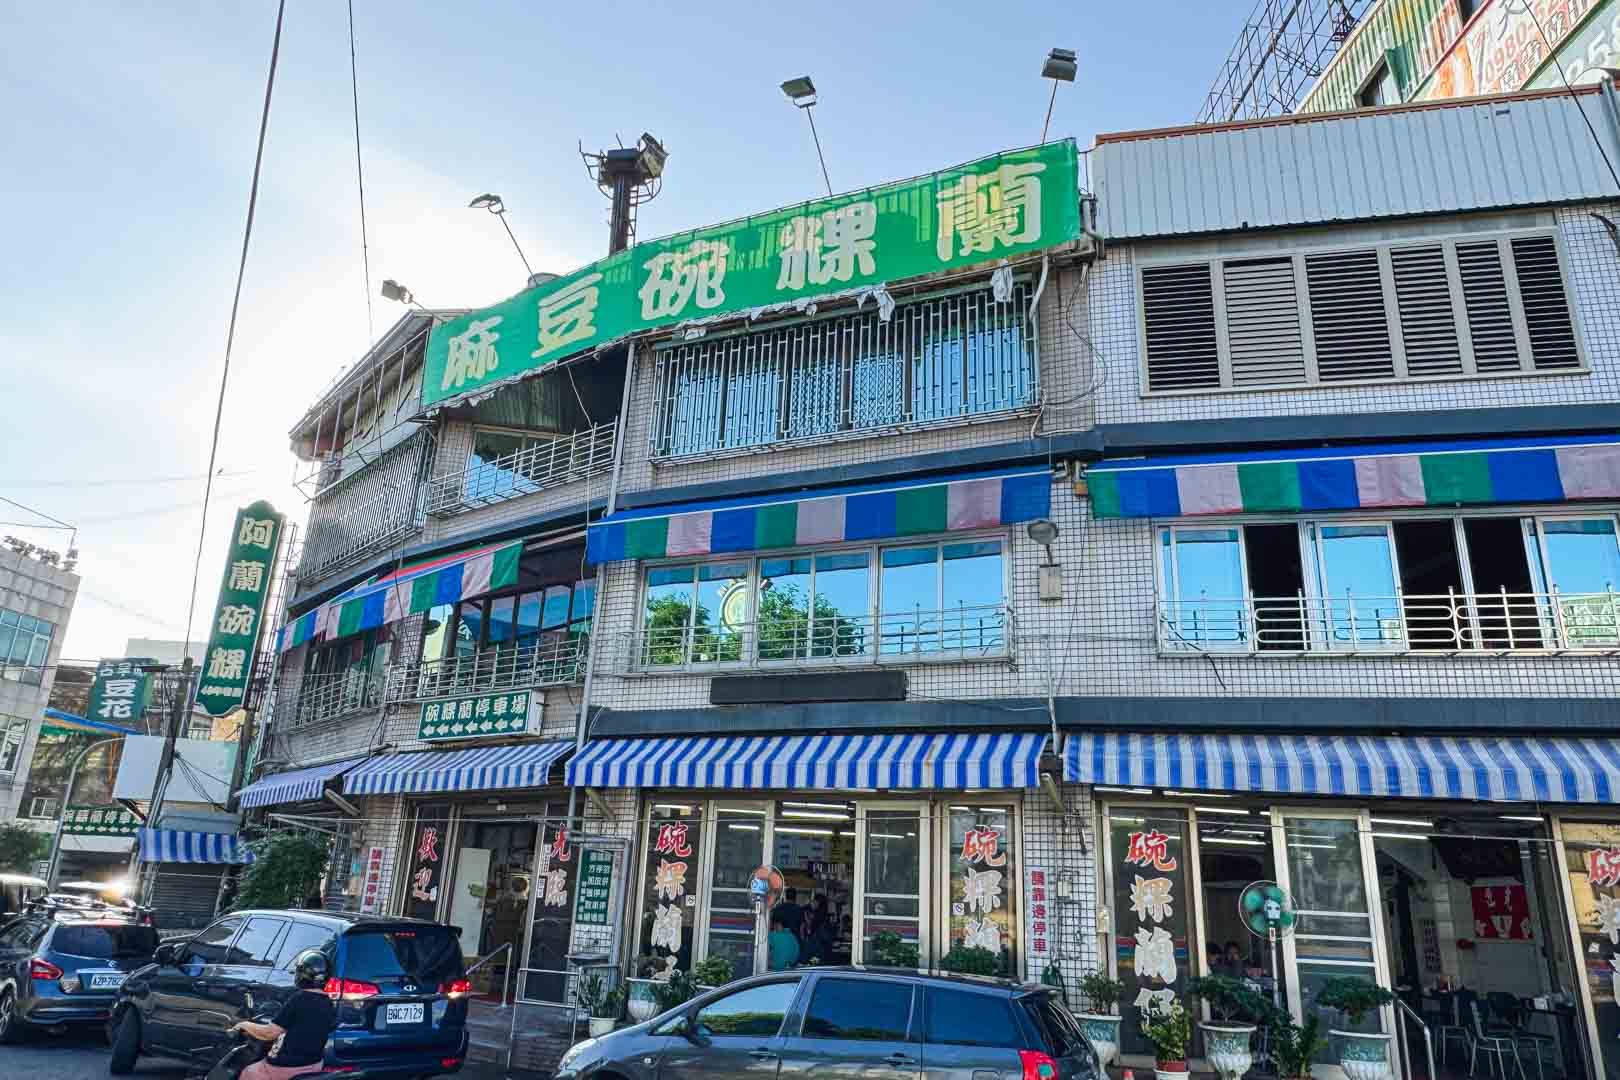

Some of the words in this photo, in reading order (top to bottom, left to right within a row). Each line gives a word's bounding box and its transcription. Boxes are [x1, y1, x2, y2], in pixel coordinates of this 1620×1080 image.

[440, 162, 1047, 392] 麻豆碗粿蘭
[207, 517, 274, 680] 阿蘭碗粿
[97, 679, 137, 718] 豆花
[425, 694, 527, 722] 碗粿蘭停車場
